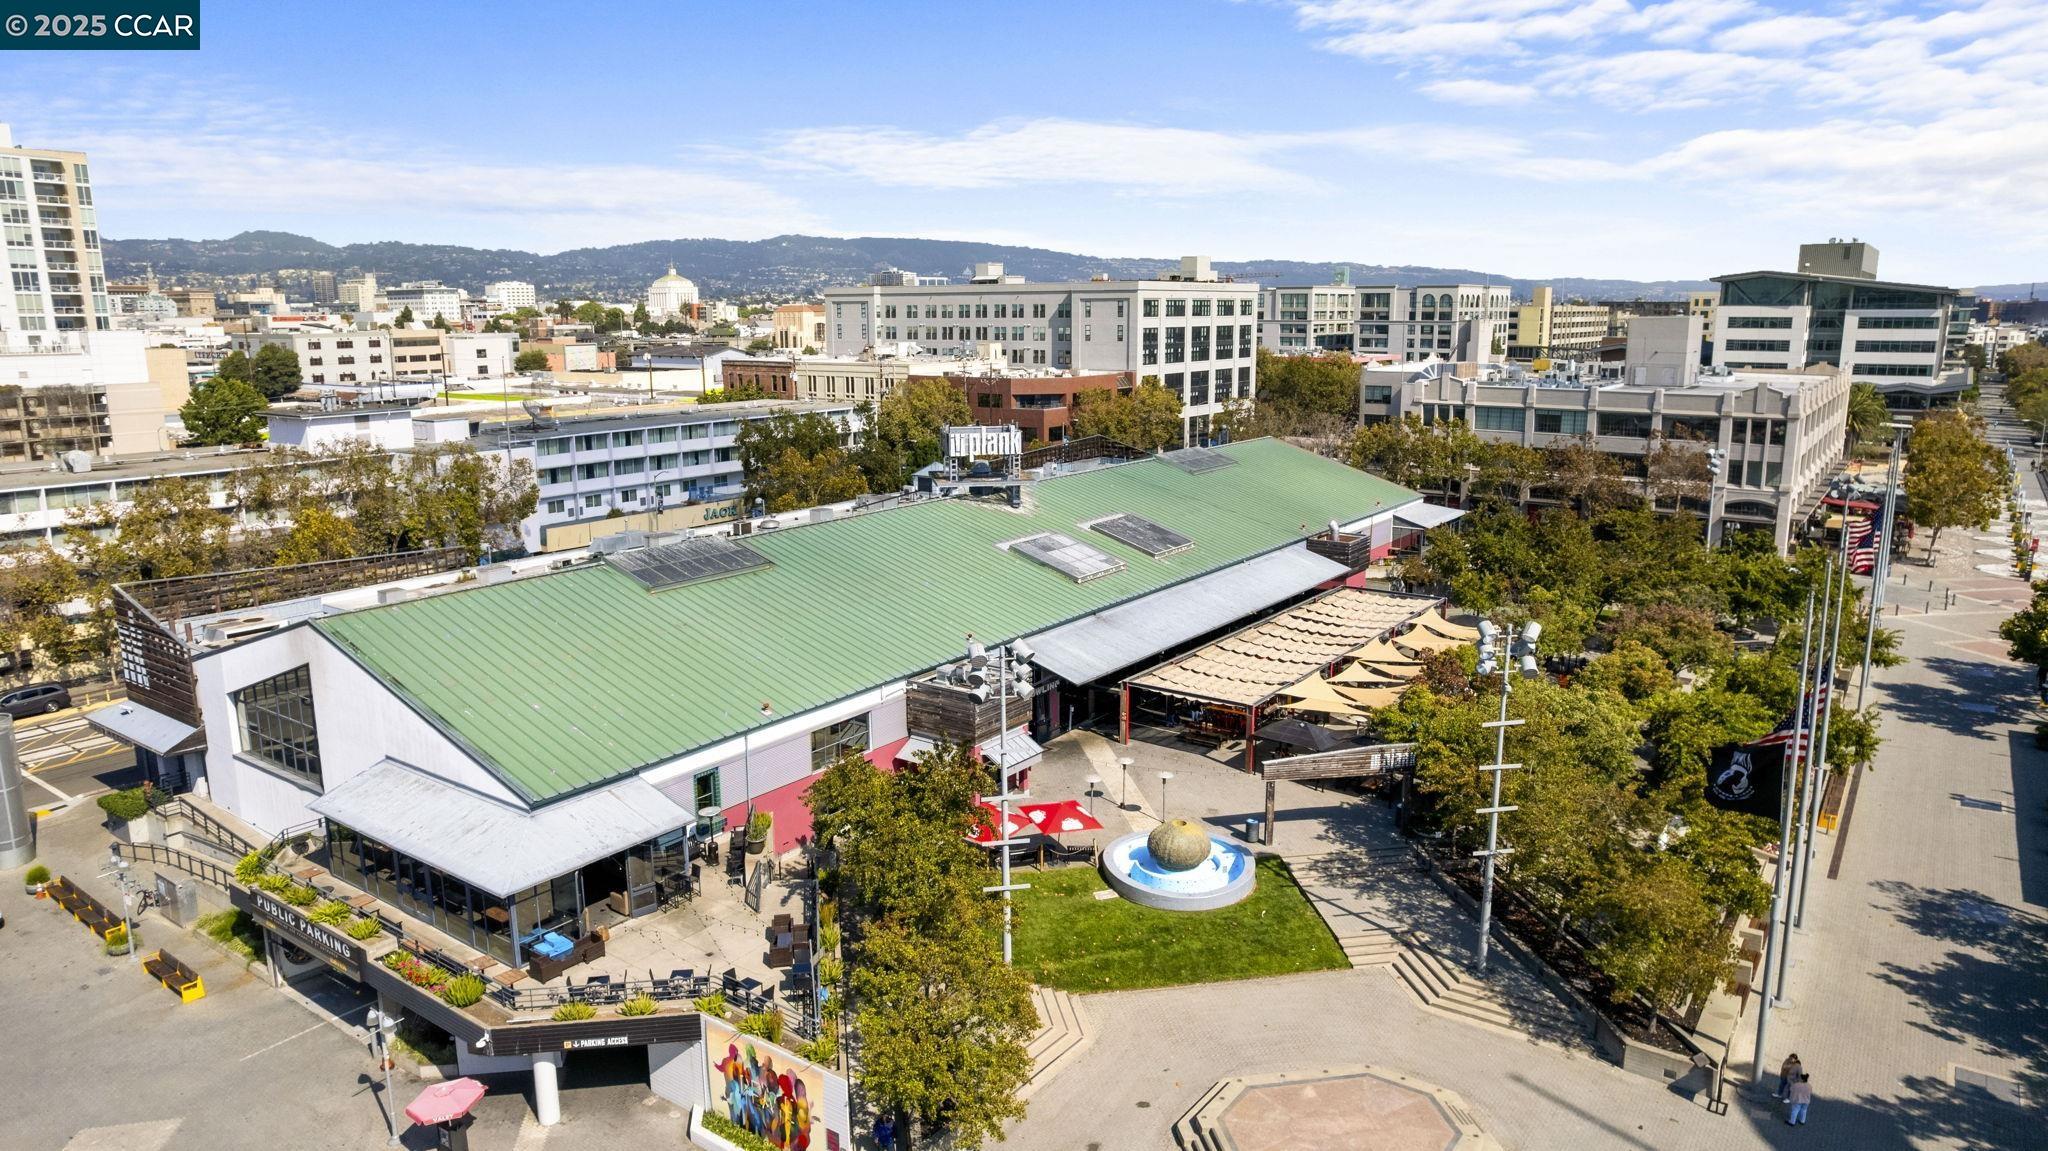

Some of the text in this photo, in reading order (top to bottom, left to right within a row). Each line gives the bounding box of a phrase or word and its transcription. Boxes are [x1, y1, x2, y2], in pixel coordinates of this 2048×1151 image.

[969, 424, 1023, 463] plank
[256, 895, 296, 926] PUBLIC
[300, 919, 351, 958] PARKING
[580, 1038, 606, 1048] PARKING
[607, 1036, 629, 1046] ACCESS
